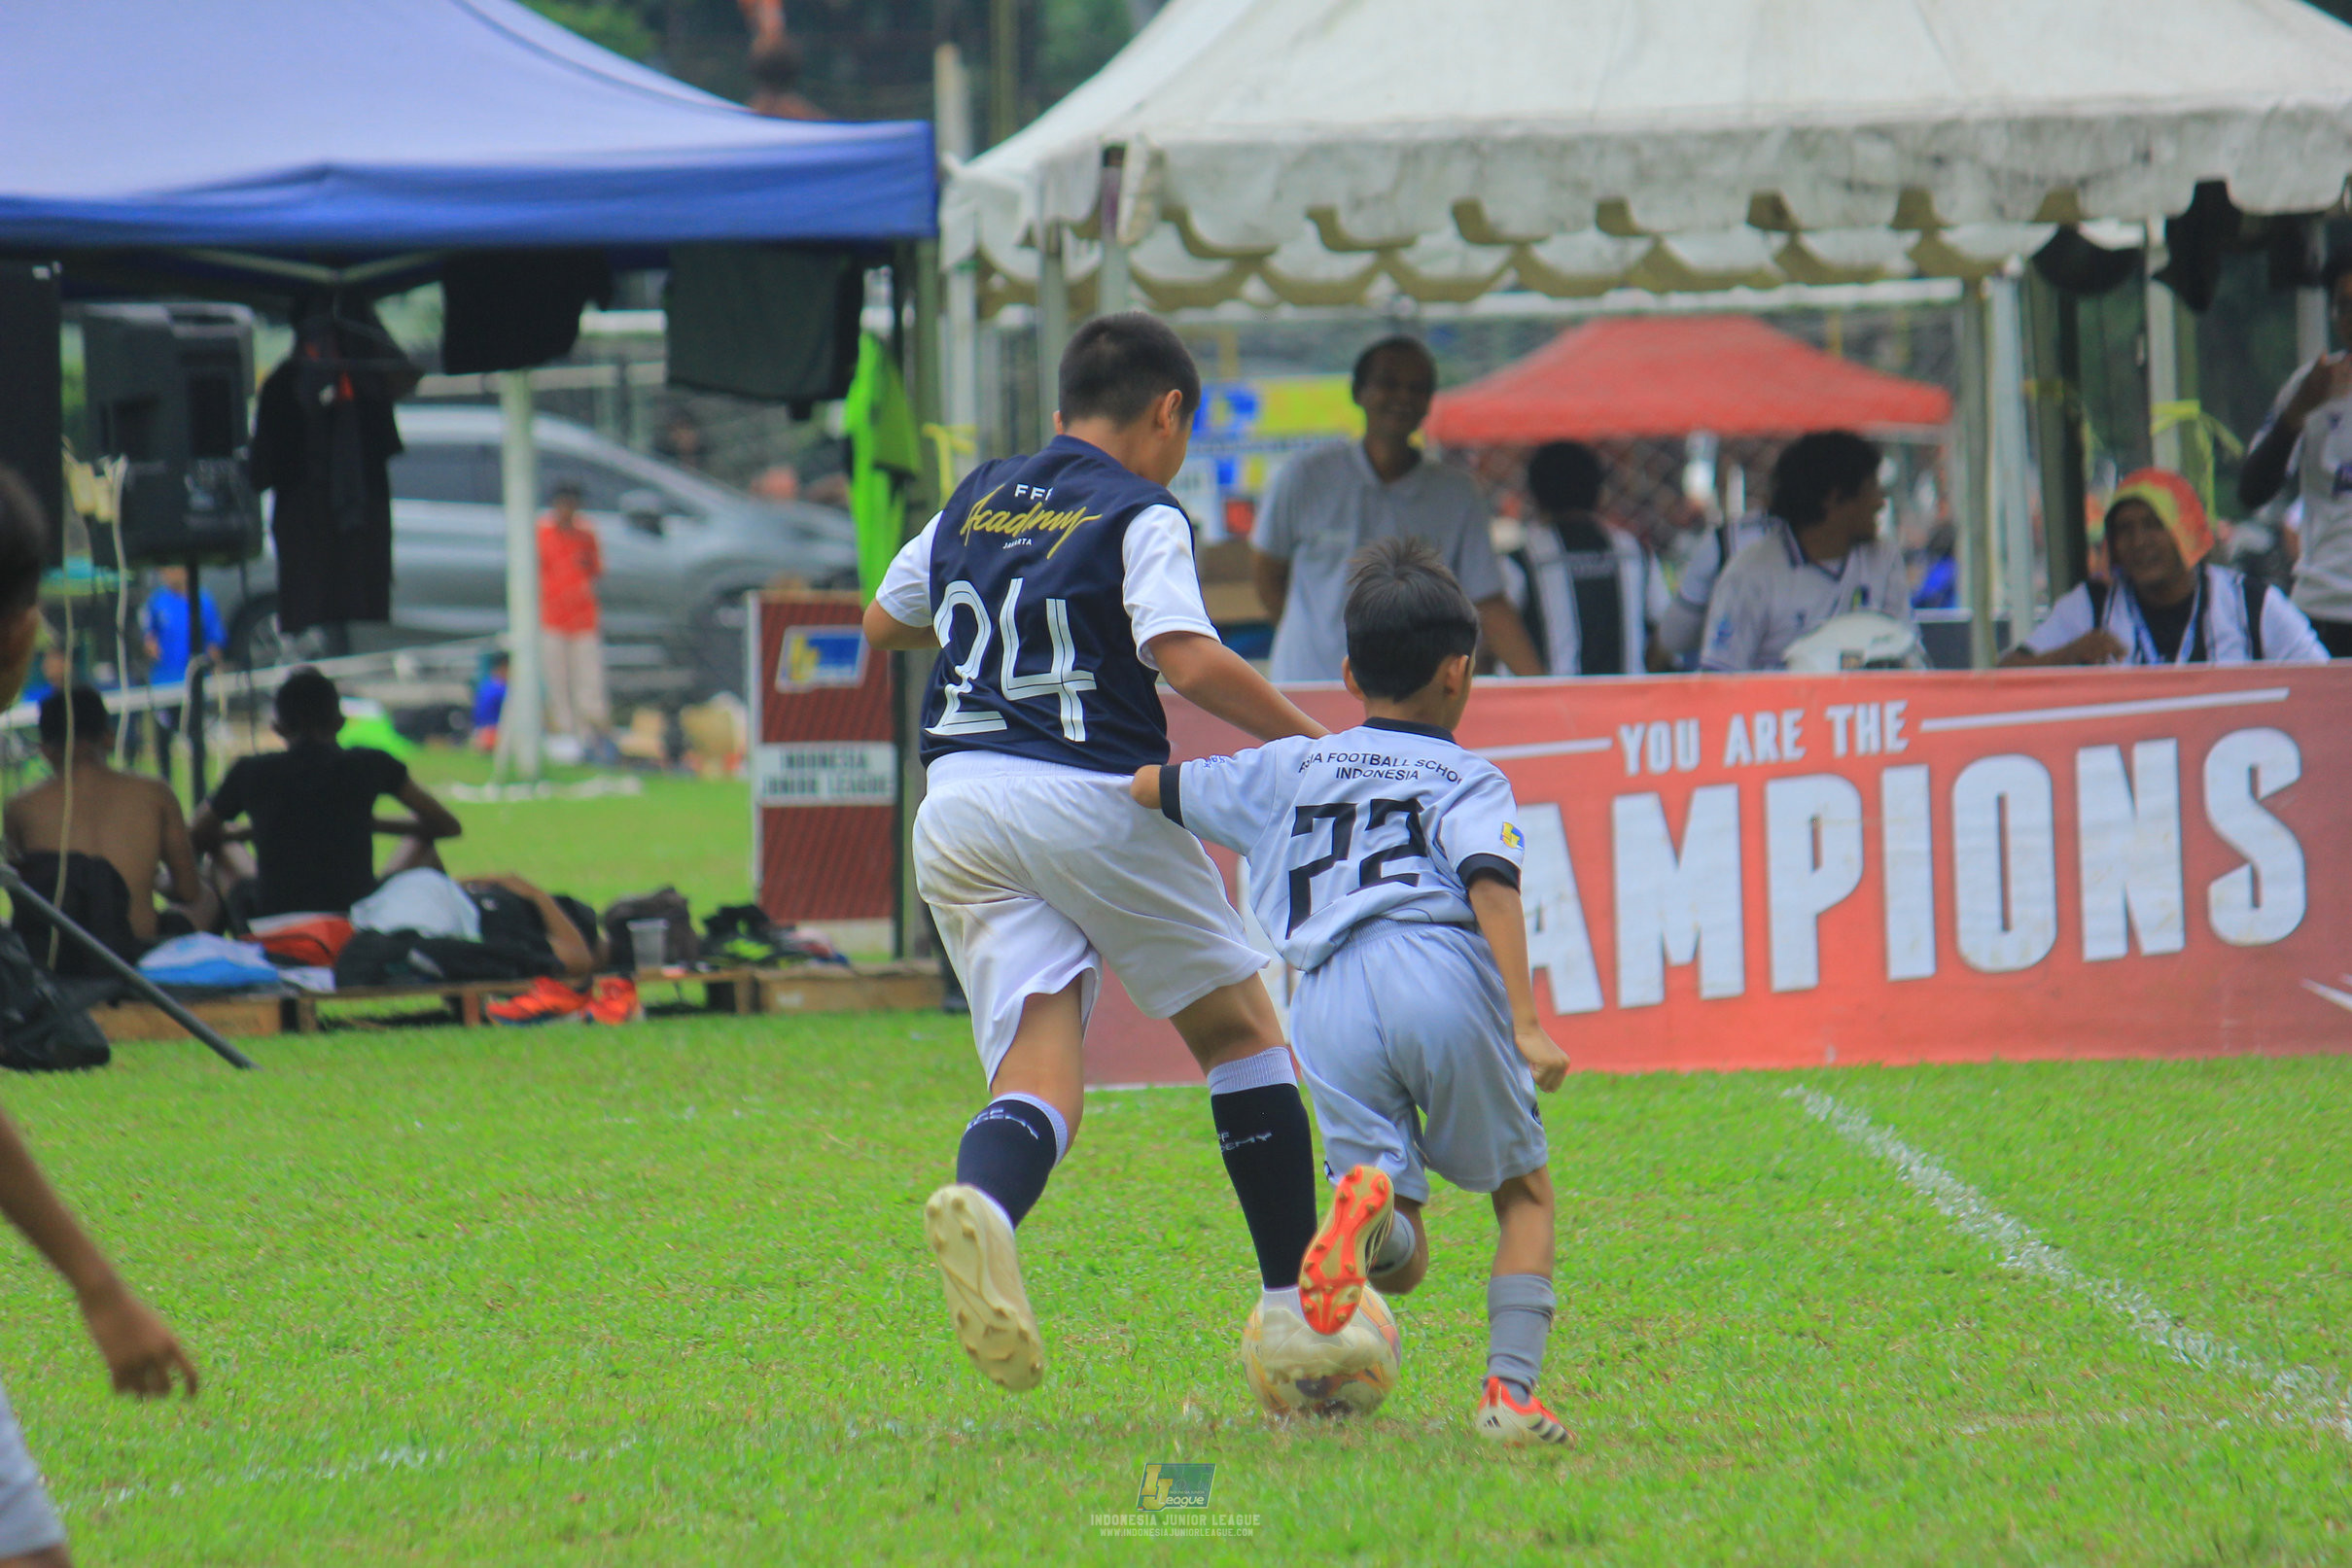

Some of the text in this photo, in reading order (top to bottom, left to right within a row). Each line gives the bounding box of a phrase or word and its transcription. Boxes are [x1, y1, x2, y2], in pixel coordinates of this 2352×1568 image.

[925, 577, 1097, 742] 24
[1327, 752, 1410, 767] FOOTBALL
[1336, 767, 1419, 781] INDONESIA
[1618, 700, 1910, 776] YOU ARE THE
[1517, 727, 2306, 1015] AMPIONS
